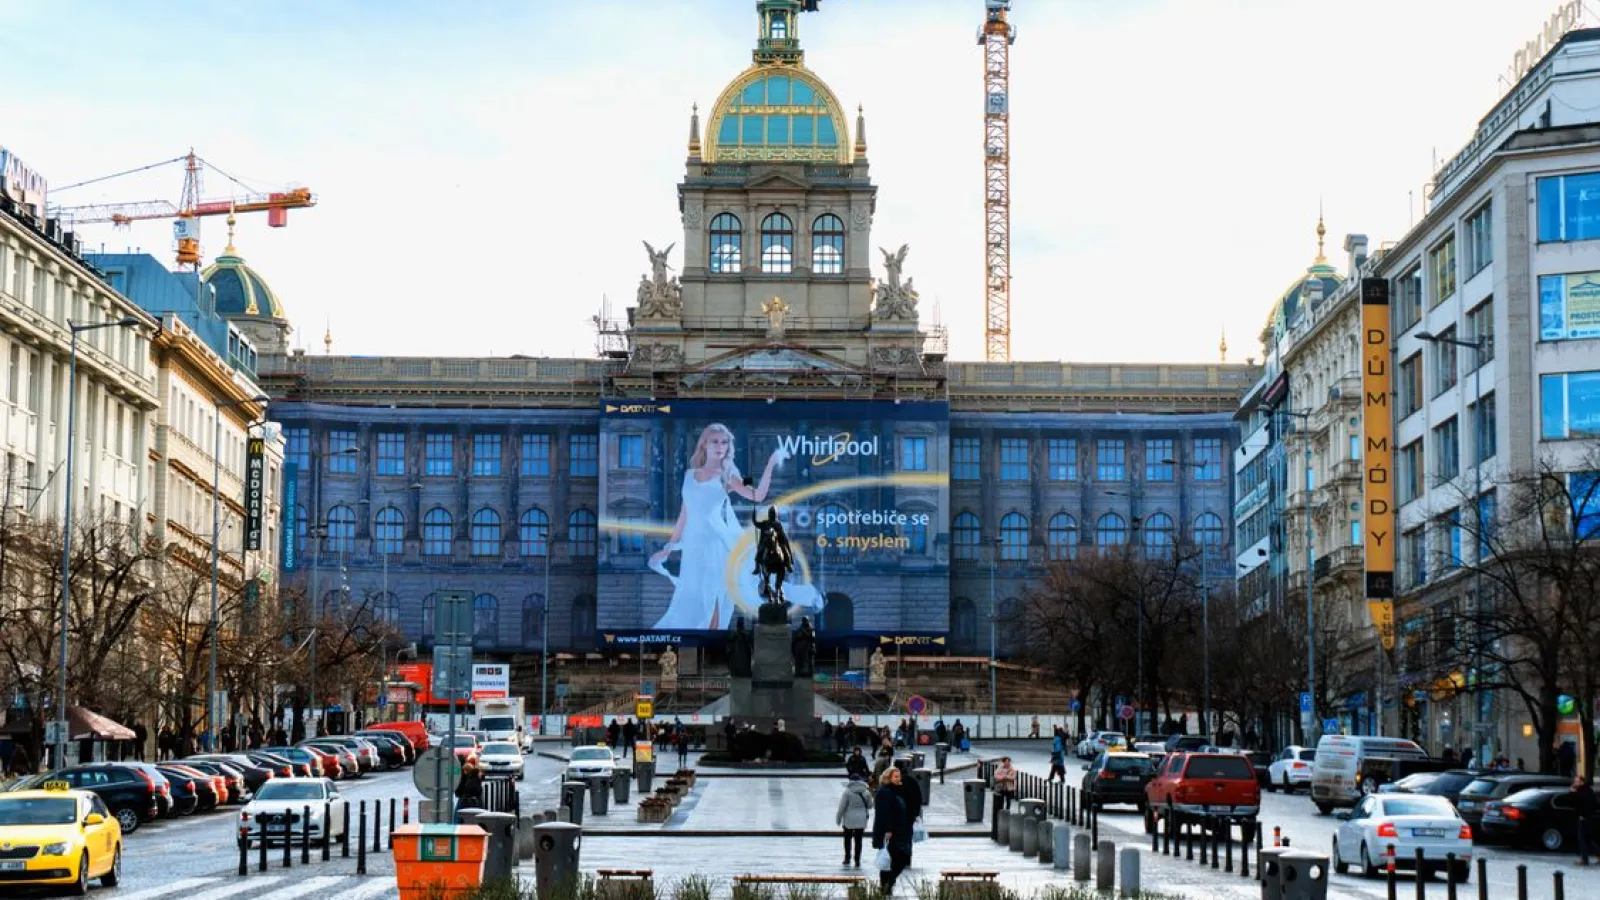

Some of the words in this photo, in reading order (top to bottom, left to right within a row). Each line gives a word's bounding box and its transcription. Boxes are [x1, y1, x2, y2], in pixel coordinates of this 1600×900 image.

[1366, 329, 1387, 408] DŮM
[777, 434, 878, 462] Whirlpool
[1367, 436, 1388, 548] MÓDY
[816, 509, 907, 528] spotřebiče
[911, 513, 930, 525] se
[817, 533, 833, 548] 6.
[836, 532, 911, 551] smyslem
[616, 634, 681, 644] www.DATART.cz
